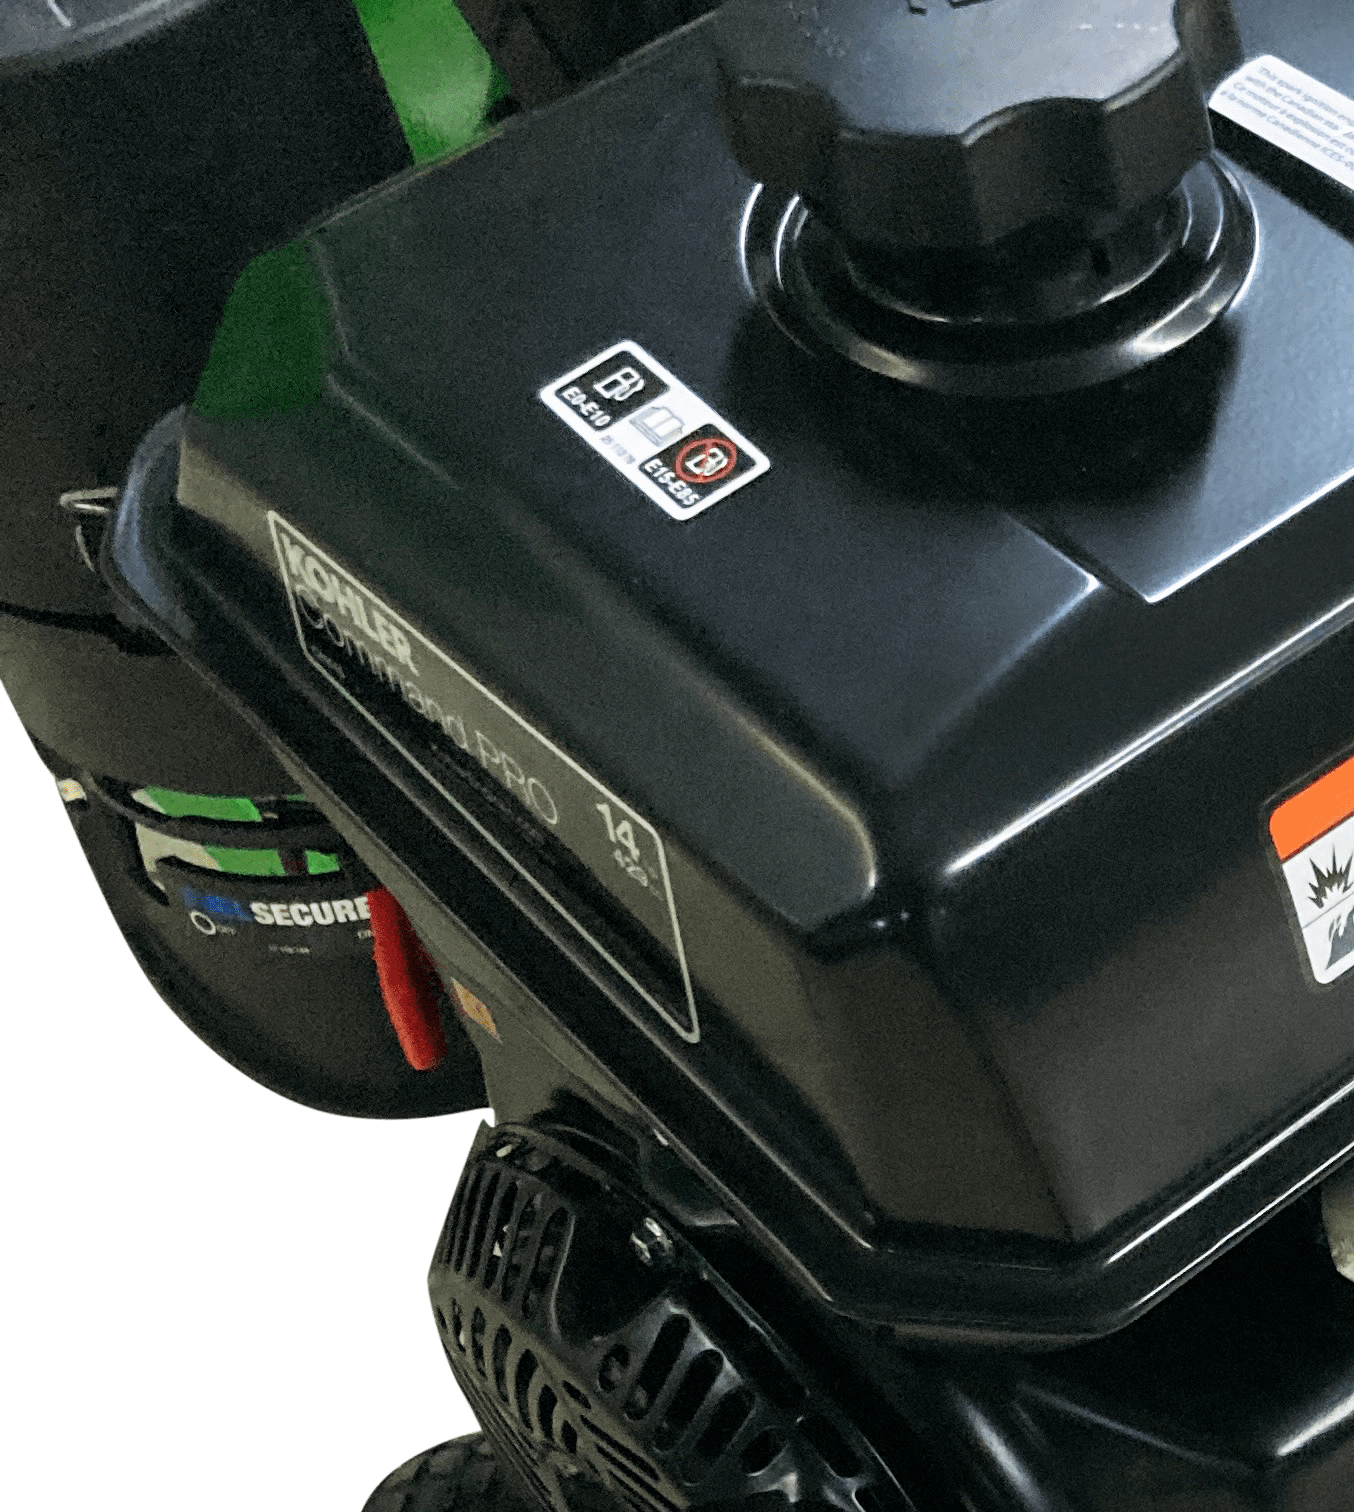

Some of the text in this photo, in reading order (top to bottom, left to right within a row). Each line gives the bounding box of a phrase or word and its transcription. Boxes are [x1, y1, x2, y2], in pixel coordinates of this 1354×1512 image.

[561, 385, 611, 427] E0-E10
[643, 458, 700, 506] E15-E85
[278, 533, 419, 676] KOHLER
[296, 583, 469, 749] Command
[475, 729, 558, 825] PRO
[595, 803, 640, 862] 14
